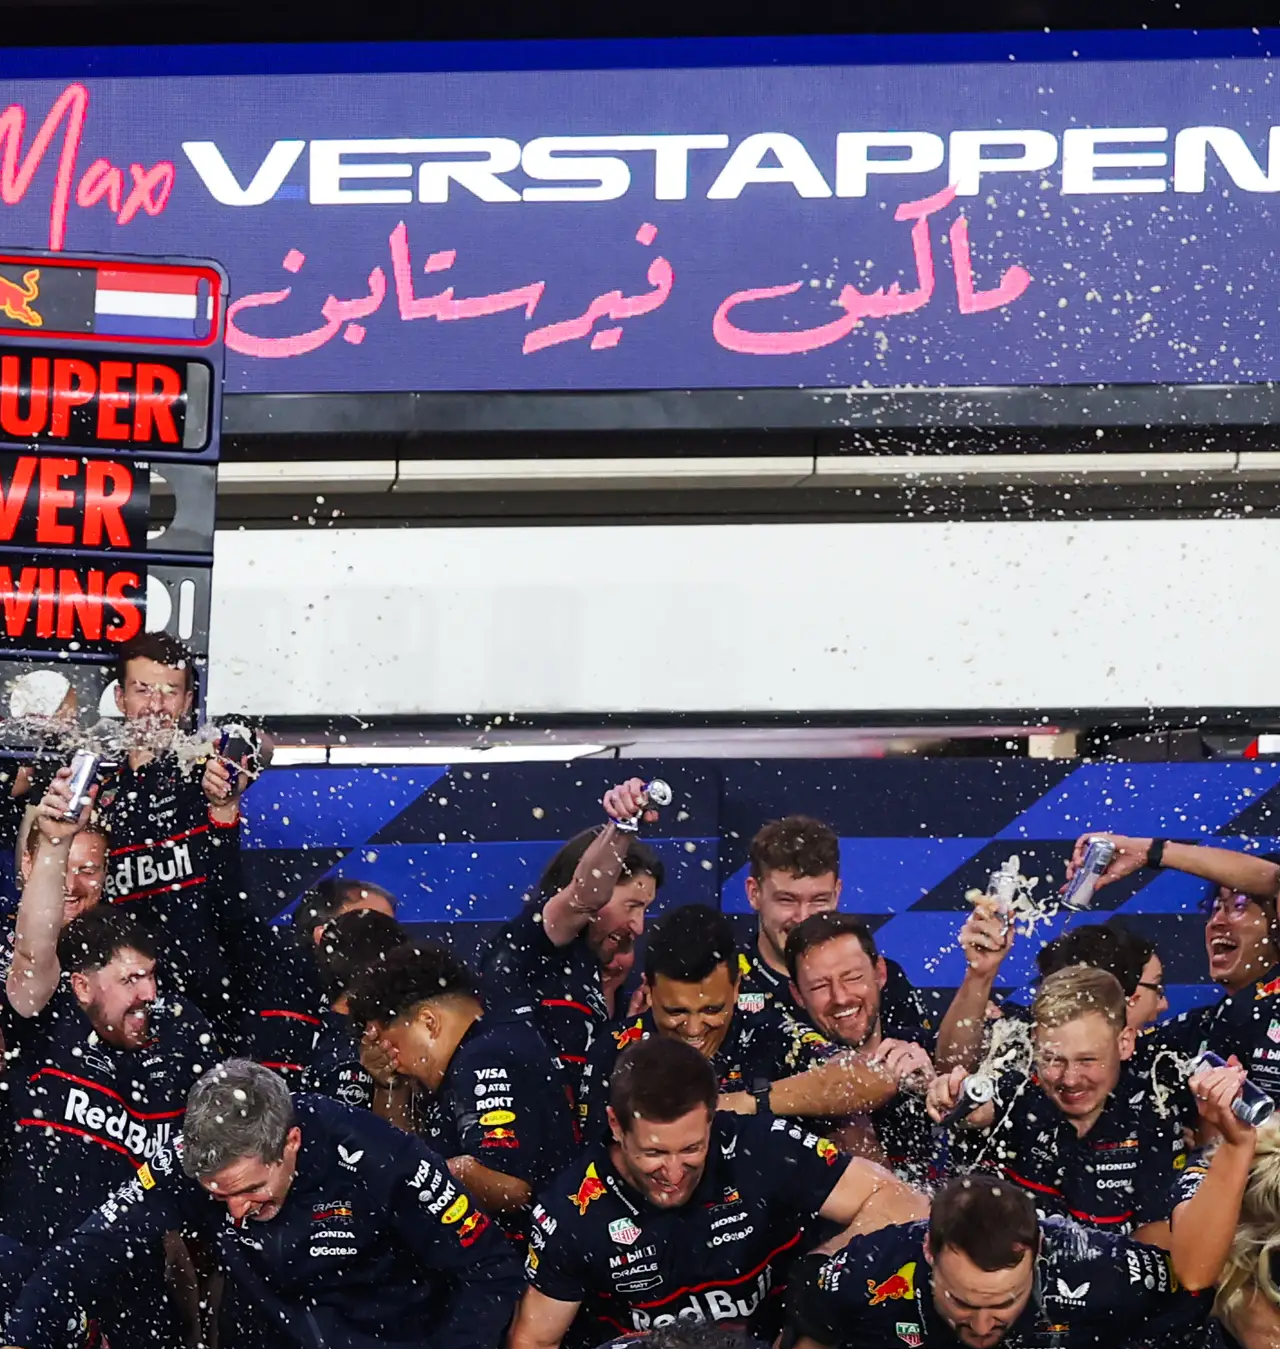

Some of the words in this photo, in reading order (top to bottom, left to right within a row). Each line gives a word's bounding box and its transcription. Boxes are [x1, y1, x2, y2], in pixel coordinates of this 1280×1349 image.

[181, 127, 1280, 206] VERSTAPPEN
[713, 181, 1031, 355] ماكس
[474, 1068, 508, 1080] VISA
[1251, 1064, 1280, 1075] ORACL
[487, 1083, 512, 1093] AT&T
[476, 1096, 513, 1111] ROKT
[406, 1159, 431, 1189] VISA
[1096, 1161, 1137, 1171] HONDA
[427, 1180, 457, 1214] ROKT
[312, 1201, 352, 1213] ORACLE
[532, 1204, 558, 1236] Mobil
[310, 1230, 356, 1240] HONDA
[320, 1246, 358, 1256] Gate.io
[609, 1250, 643, 1269] Mobil
[1127, 1250, 1141, 1284] VISA
[612, 1263, 658, 1280] ORACLE
